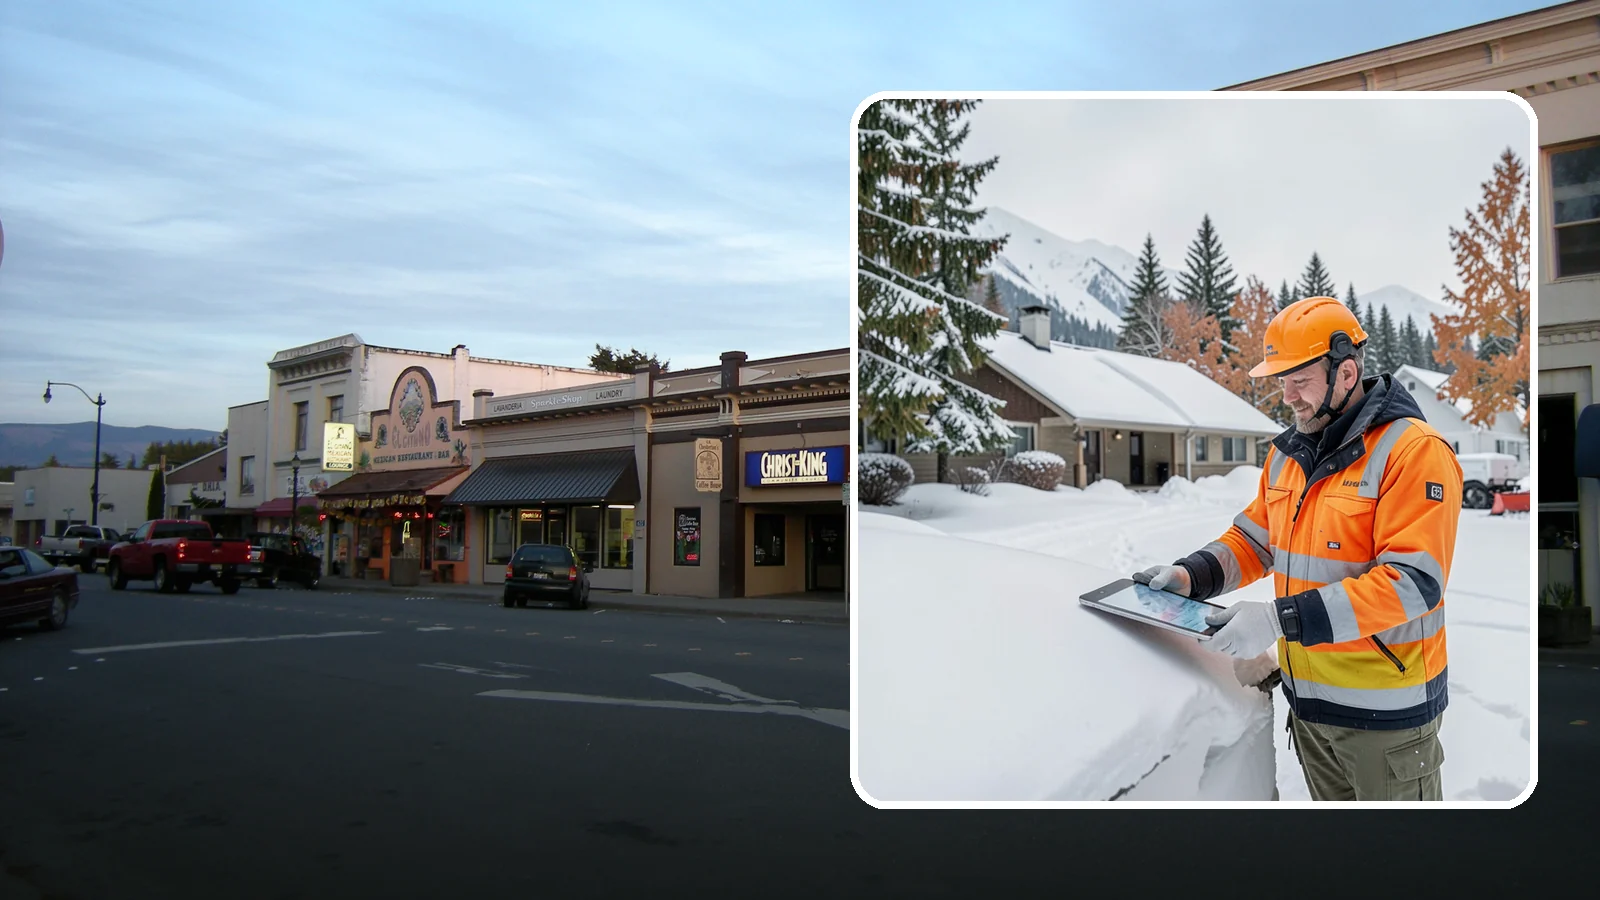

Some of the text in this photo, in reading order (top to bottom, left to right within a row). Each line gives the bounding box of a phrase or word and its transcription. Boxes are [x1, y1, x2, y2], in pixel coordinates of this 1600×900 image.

[493, 390, 624, 412] LAVANDERIA Sparkle Shop LAUNDRY
[373, 450, 450, 464] MEXICAN RESTAURANT BAR
[799, 450, 827, 476] KING
